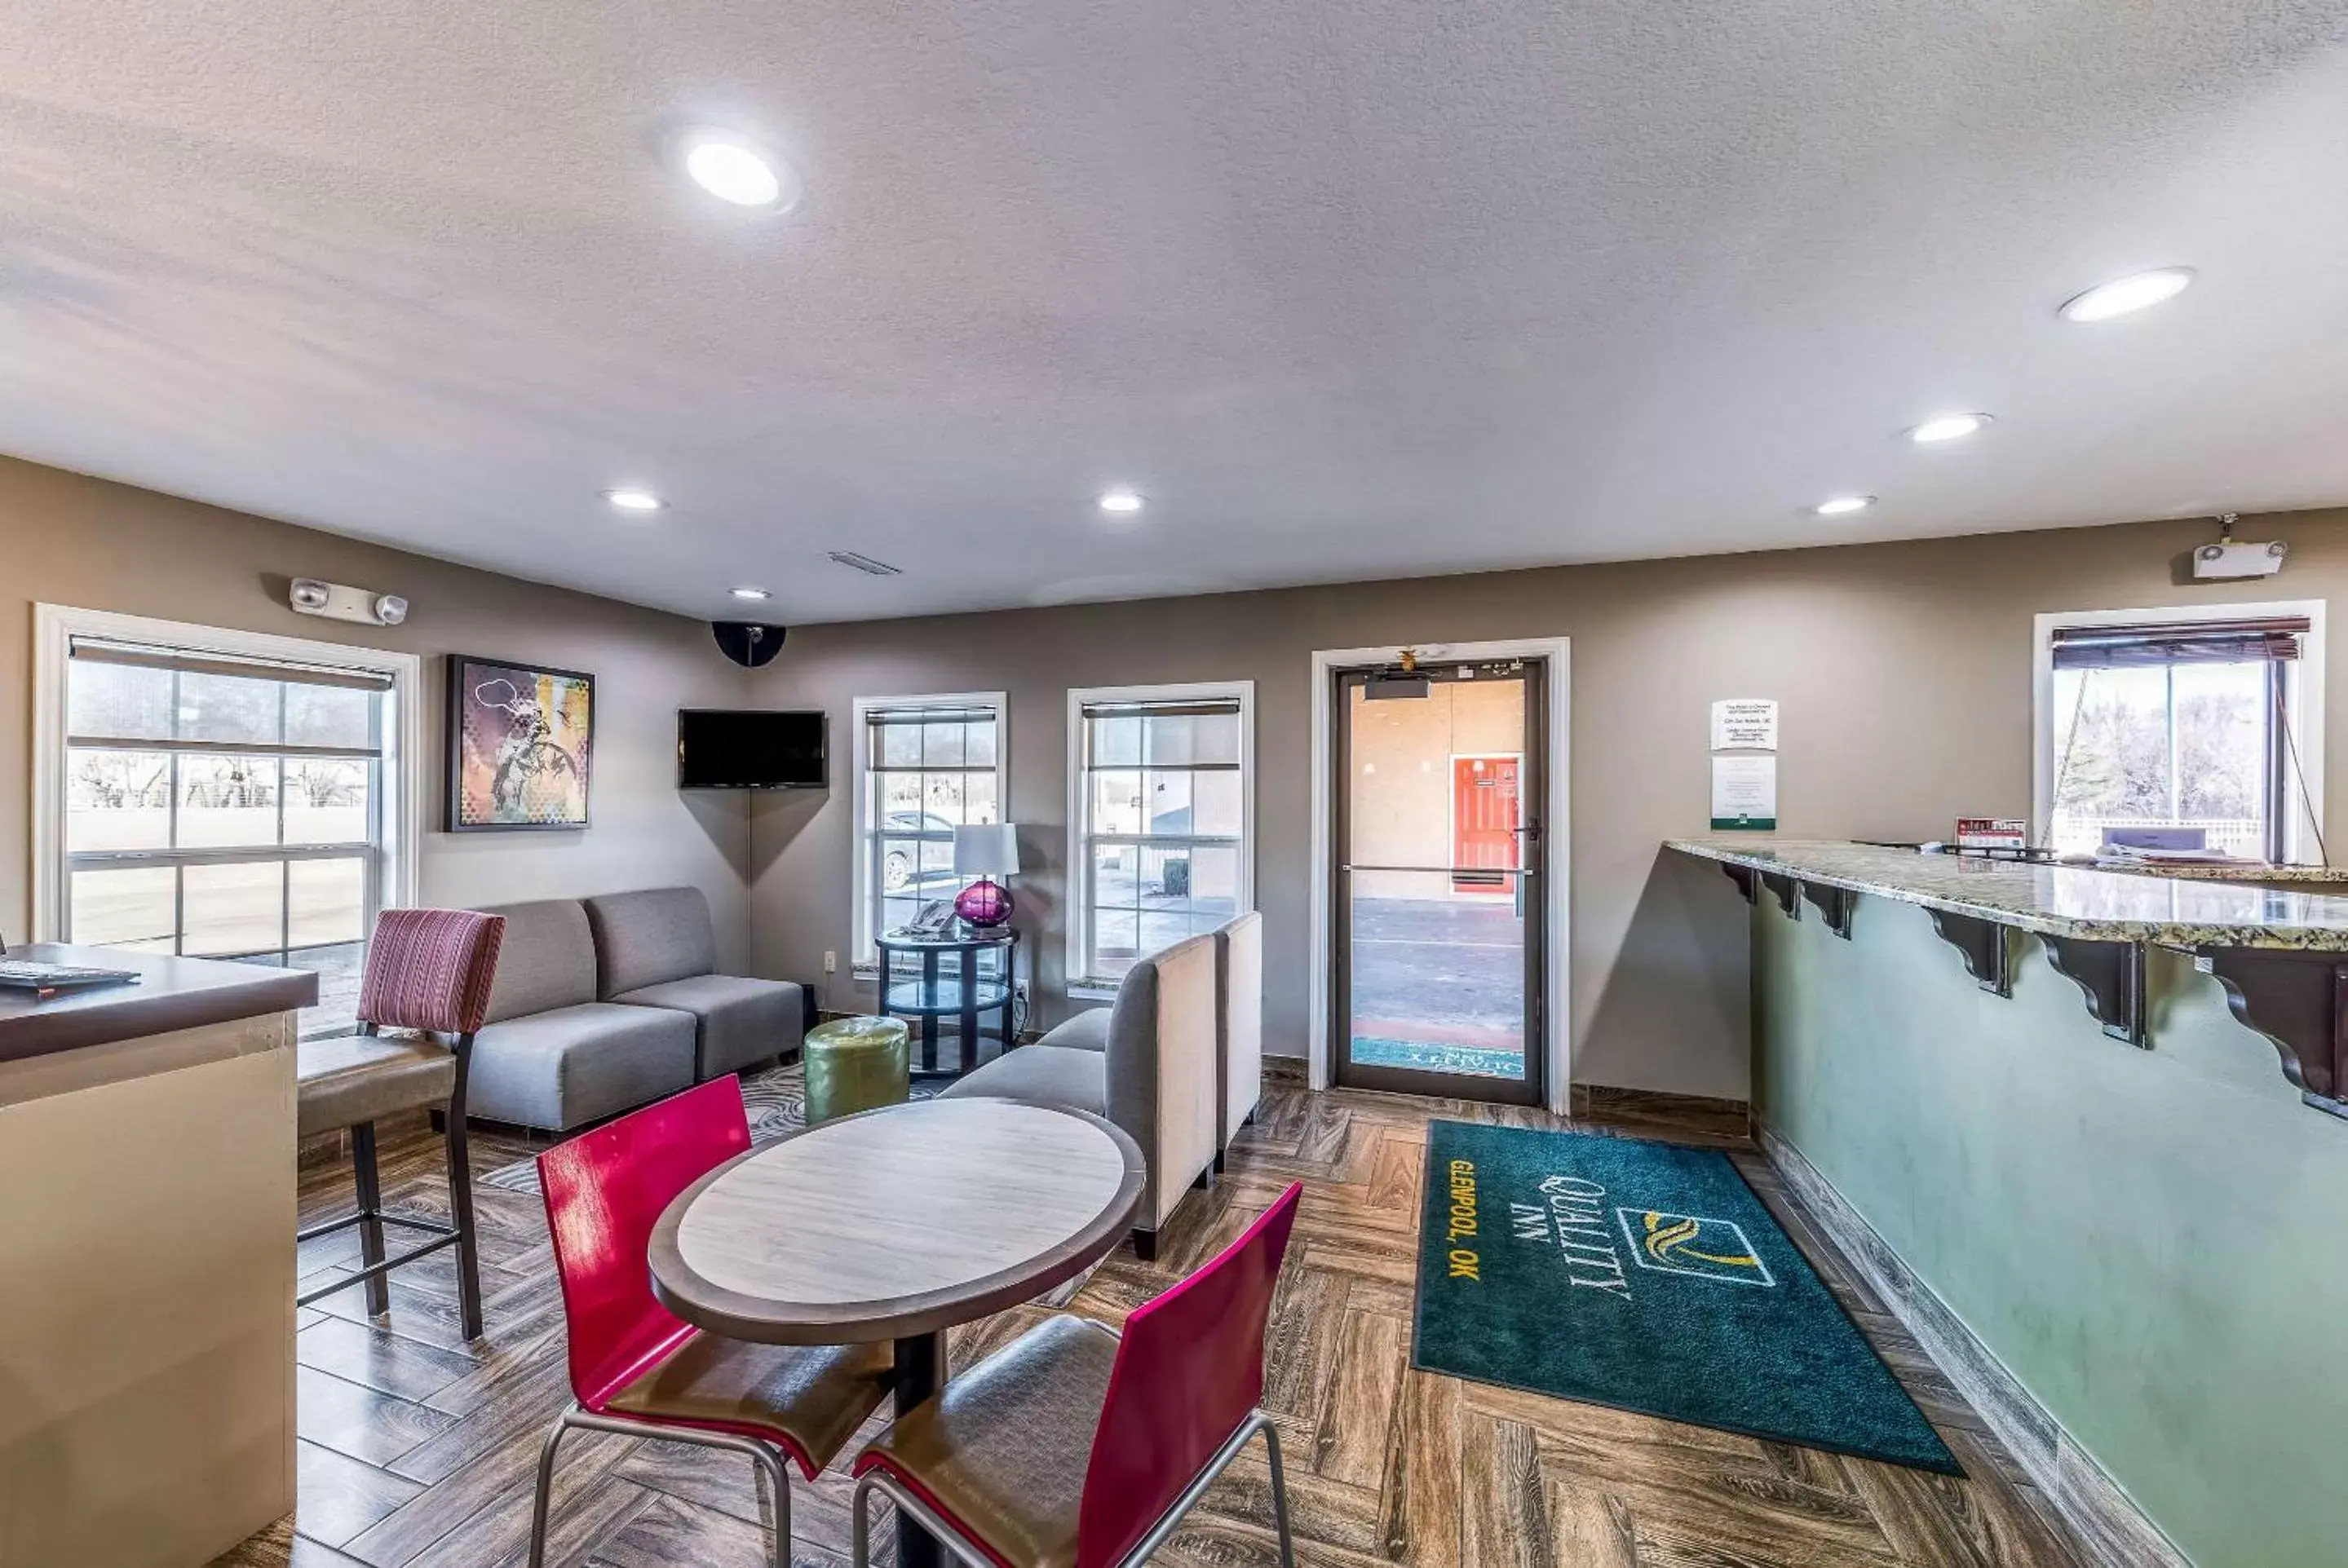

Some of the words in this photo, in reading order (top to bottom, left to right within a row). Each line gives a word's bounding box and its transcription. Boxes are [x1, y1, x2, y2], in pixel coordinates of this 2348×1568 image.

[1447, 1160, 1478, 1243] GLENPOOL,
[1510, 1203, 1552, 1243] INN
[1448, 1250, 1480, 1282] OK
[1538, 1175, 1632, 1301] QUALITY
